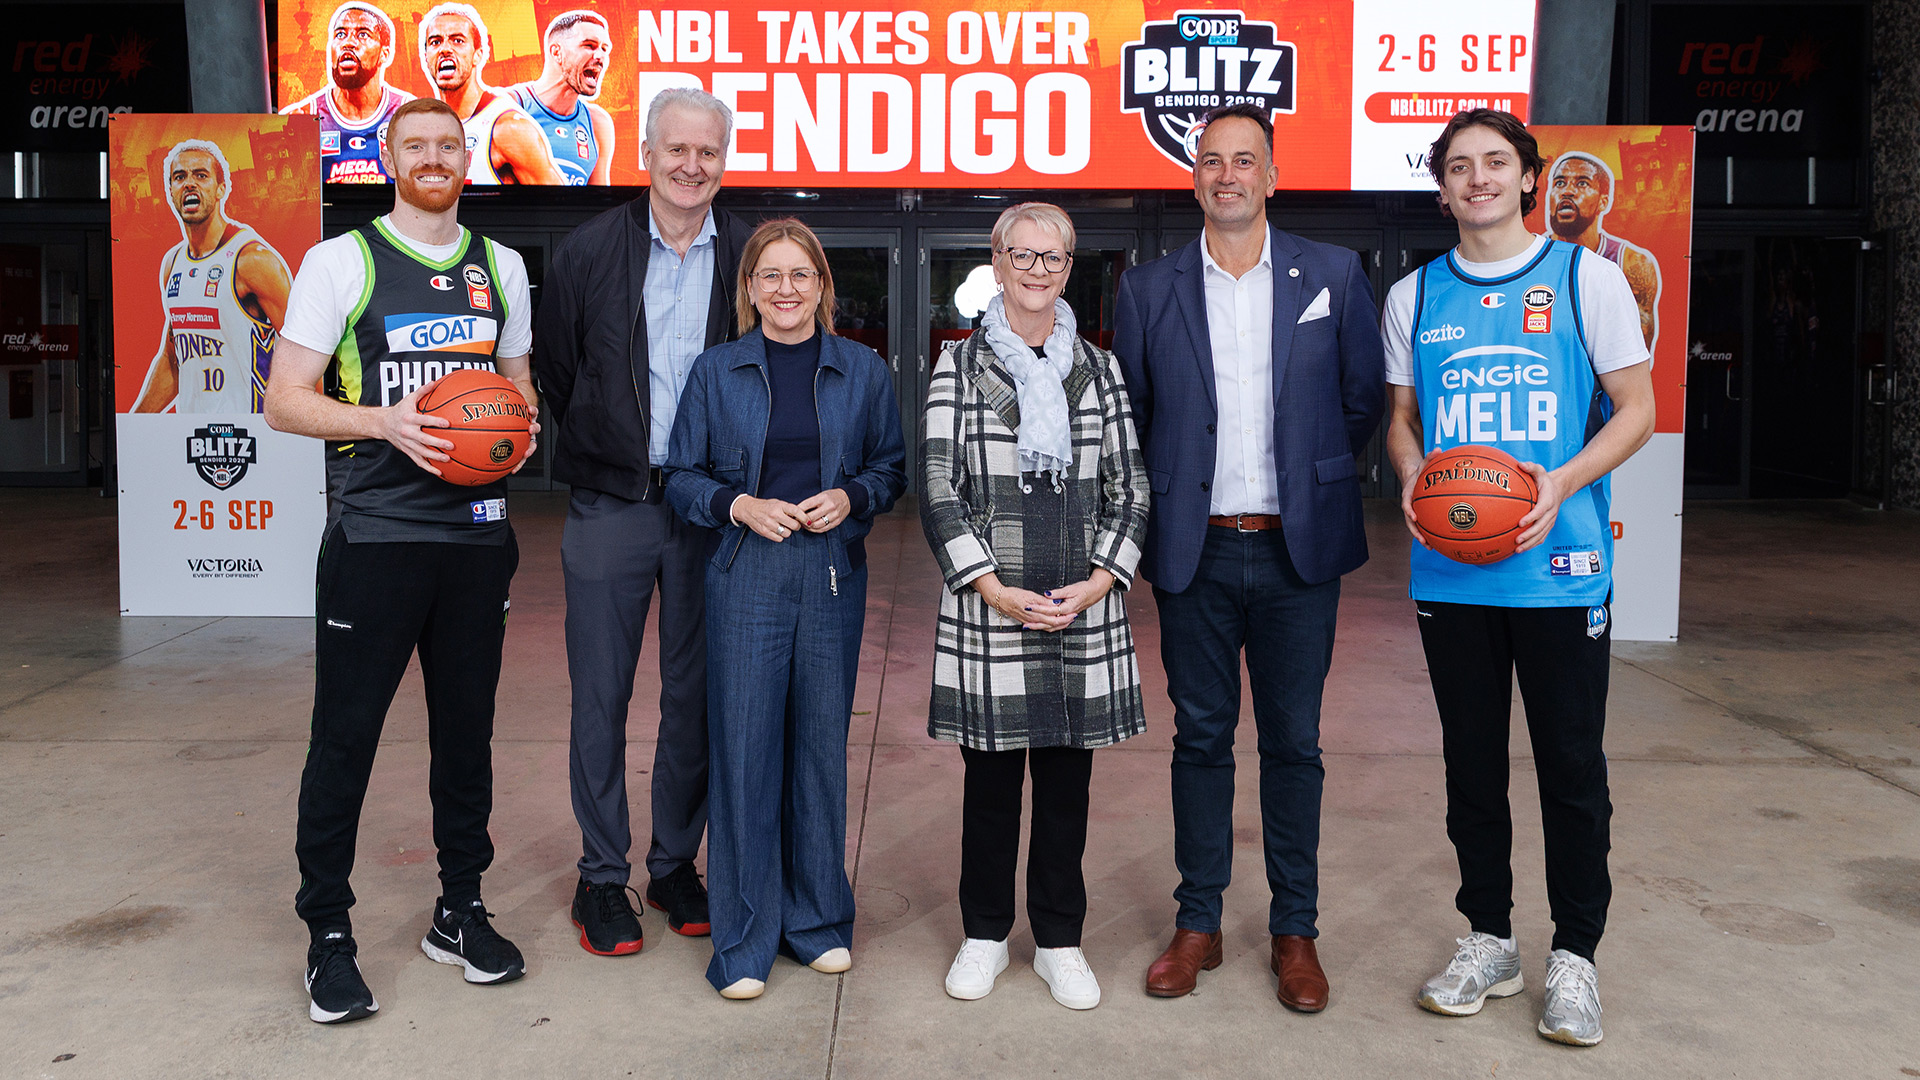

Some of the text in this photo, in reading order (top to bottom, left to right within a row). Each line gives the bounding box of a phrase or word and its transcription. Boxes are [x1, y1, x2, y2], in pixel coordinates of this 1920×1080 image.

[638, 10, 1090, 65] NBL TAKES OVER
[1182, 19, 1240, 37] CODE
[1210, 36, 1237, 44] SPORTS
[12, 34, 93, 73] red
[1378, 34, 1527, 72] 2-6 SEP
[1678, 34, 1764, 75] red
[1134, 46, 1283, 95] BLITZ
[29, 77, 110, 99] energy
[1696, 80, 1781, 103] energy
[1154, 95, 1266, 108] BENDIGO 2026
[638, 71, 1091, 174] ENDIGO
[1695, 108, 1804, 132] arena
[330, 160, 379, 178] MEGA
[469, 271, 485, 284] NBL
[1529, 292, 1549, 305] NBL
[2, 332, 26, 344] red
[410, 317, 477, 348] GOAT
[1420, 323, 1466, 345] ozito
[38, 343, 69, 352] arena
[175, 332, 225, 366] DNEY
[1699, 352, 1733, 361] arena
[202, 367, 225, 392] 10
[1435, 390, 1558, 445] MELB
[209, 425, 234, 434] CODE
[190, 437, 252, 458] BLITZ
[495, 446, 509, 457] NBL
[216, 473, 228, 481] NBL
[1423, 467, 1511, 492] SPALDING
[173, 499, 274, 531] 2-6 SEP
[1453, 511, 1471, 523] NBL
